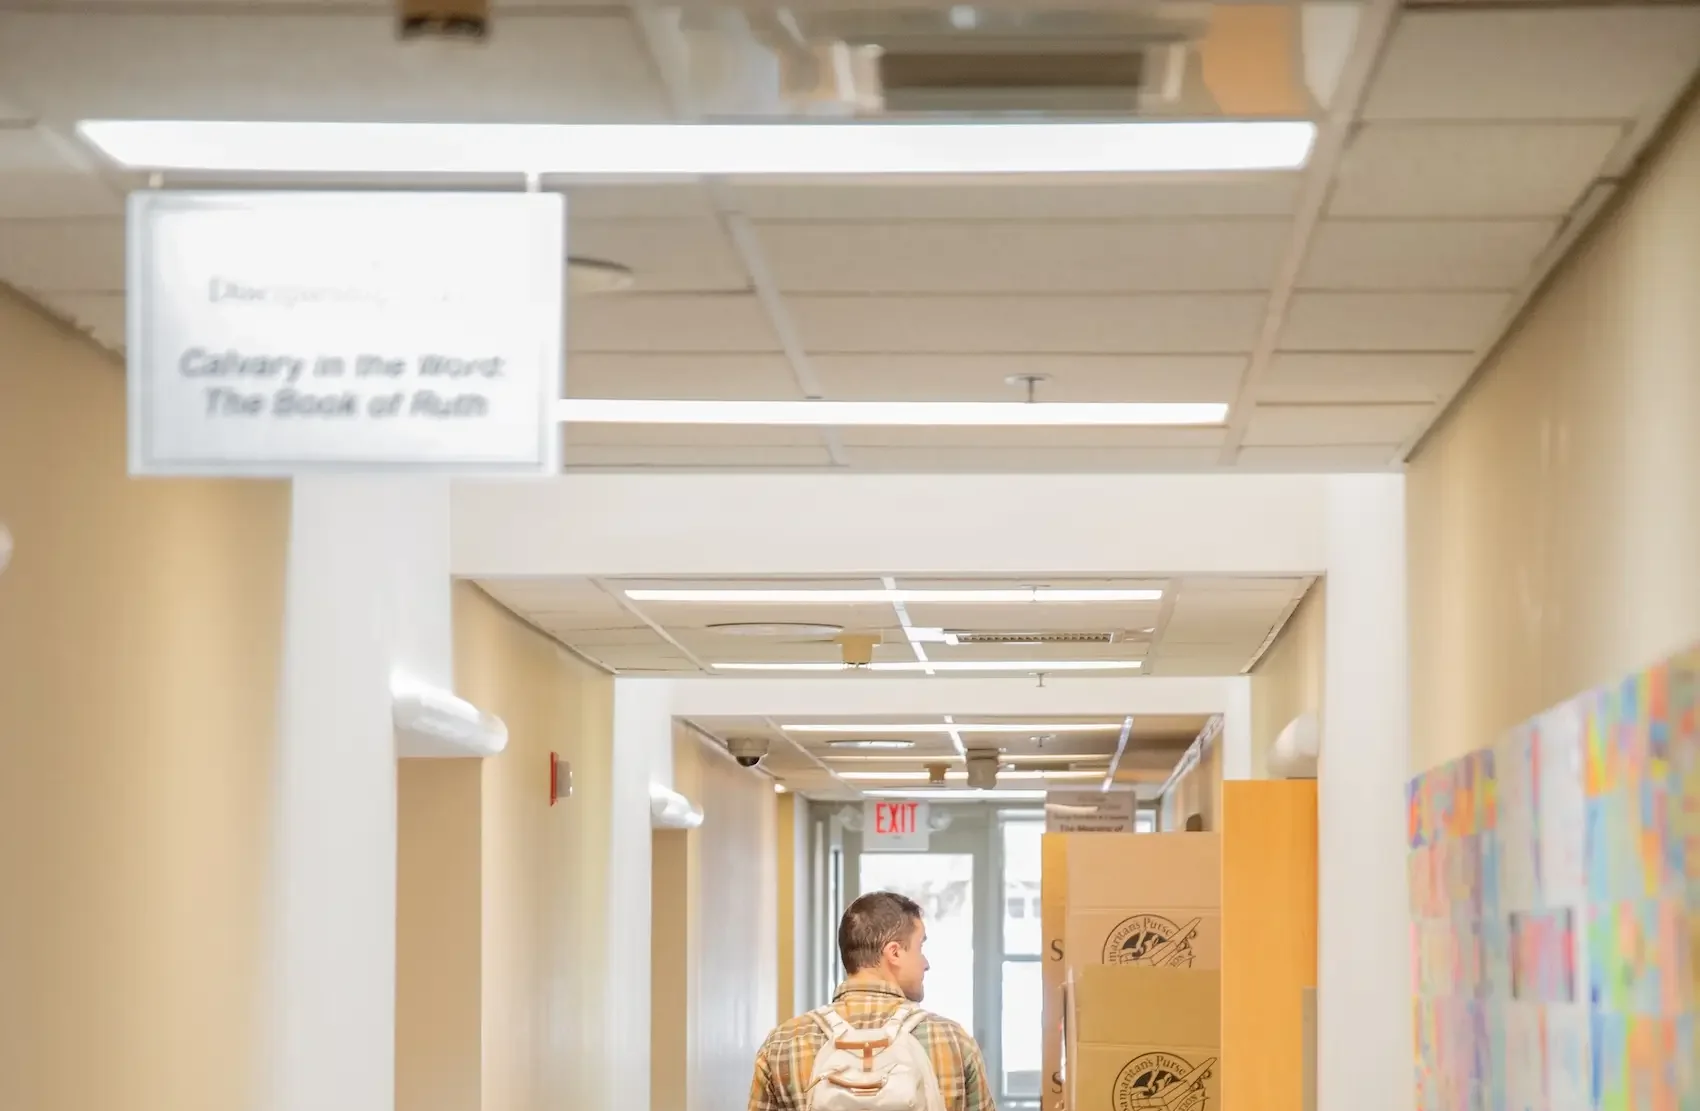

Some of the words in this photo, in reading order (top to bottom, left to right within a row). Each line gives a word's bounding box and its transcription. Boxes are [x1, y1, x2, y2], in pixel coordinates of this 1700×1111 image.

[179, 346, 304, 382] Calvary
[313, 352, 345, 377] in
[355, 350, 405, 377] the
[205, 387, 262, 417] The
[272, 387, 355, 418] Book
[367, 388, 404, 418] of
[408, 388, 488, 418] Ruth
[875, 801, 919, 834] EXIT
[1144, 916, 1174, 936] Purse
[1155, 1055, 1187, 1076] Purse
